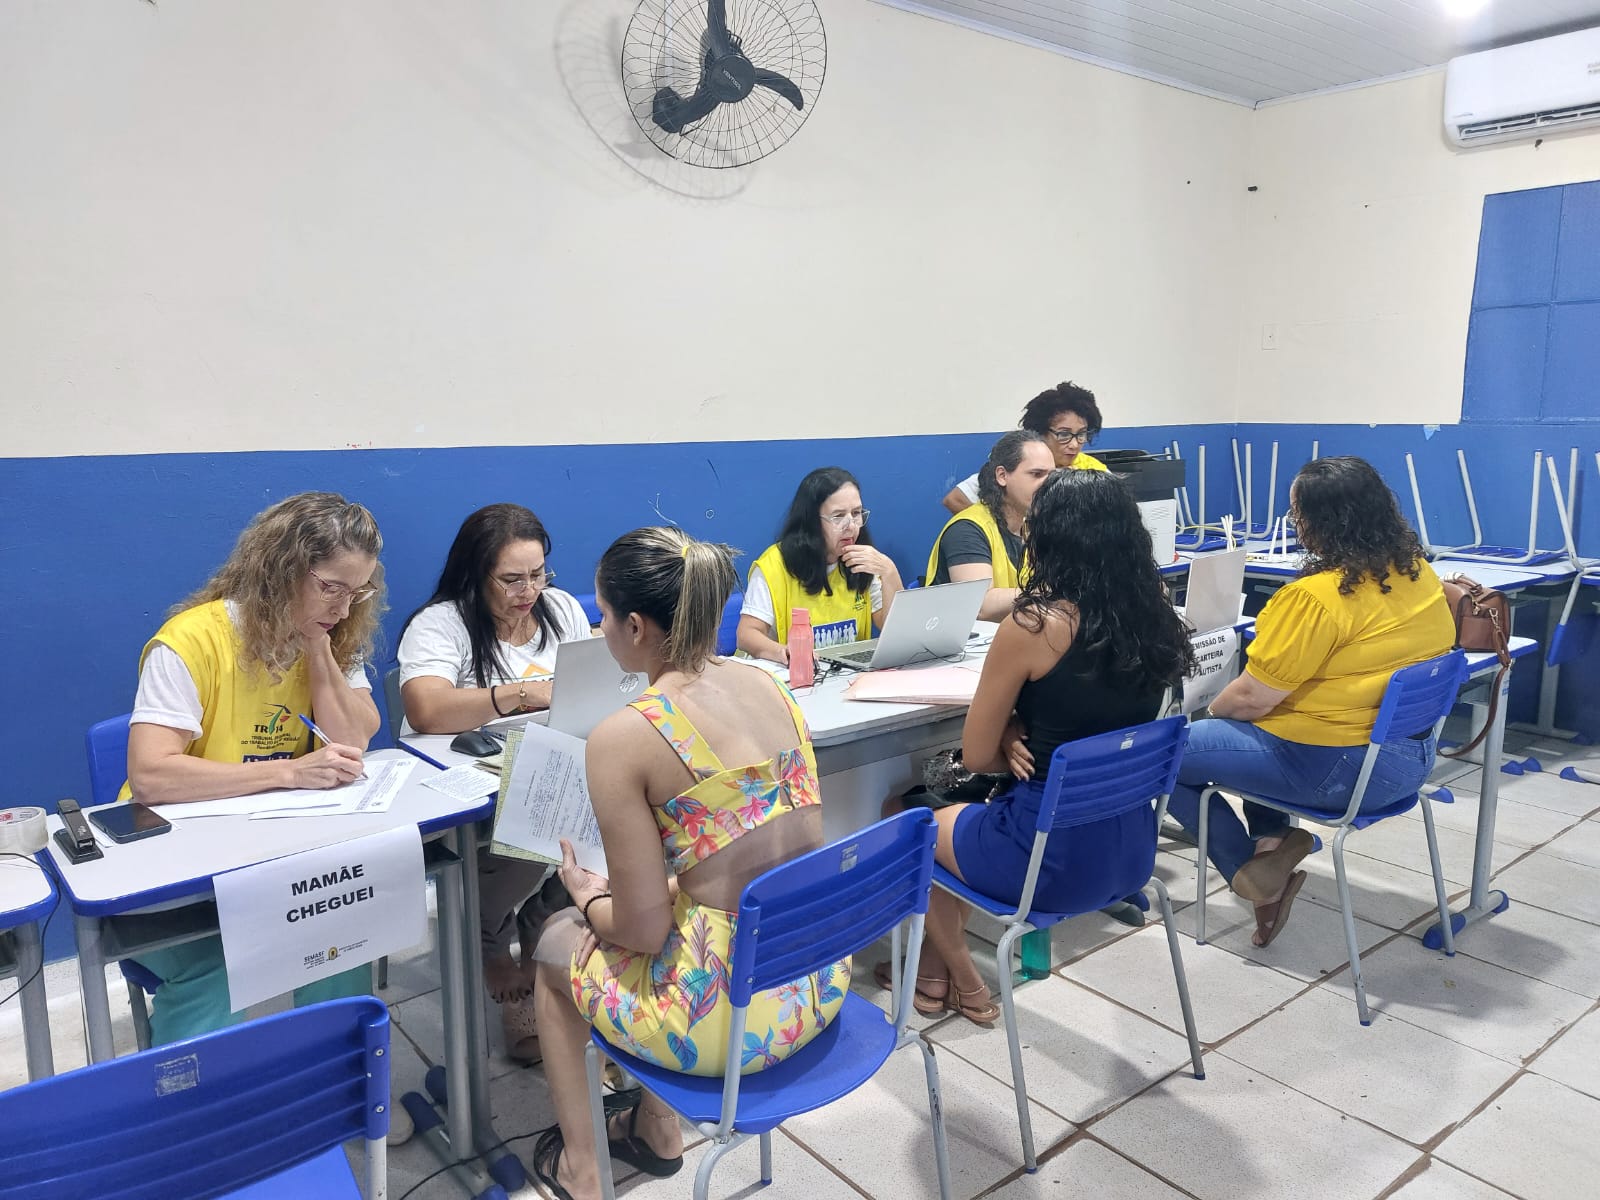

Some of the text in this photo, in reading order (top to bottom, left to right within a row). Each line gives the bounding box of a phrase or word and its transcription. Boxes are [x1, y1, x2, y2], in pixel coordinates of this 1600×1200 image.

[1218, 635, 1226, 644] DE
[291, 864, 365, 896] MAMÃE
[286, 886, 374, 923] CHEGUEI
